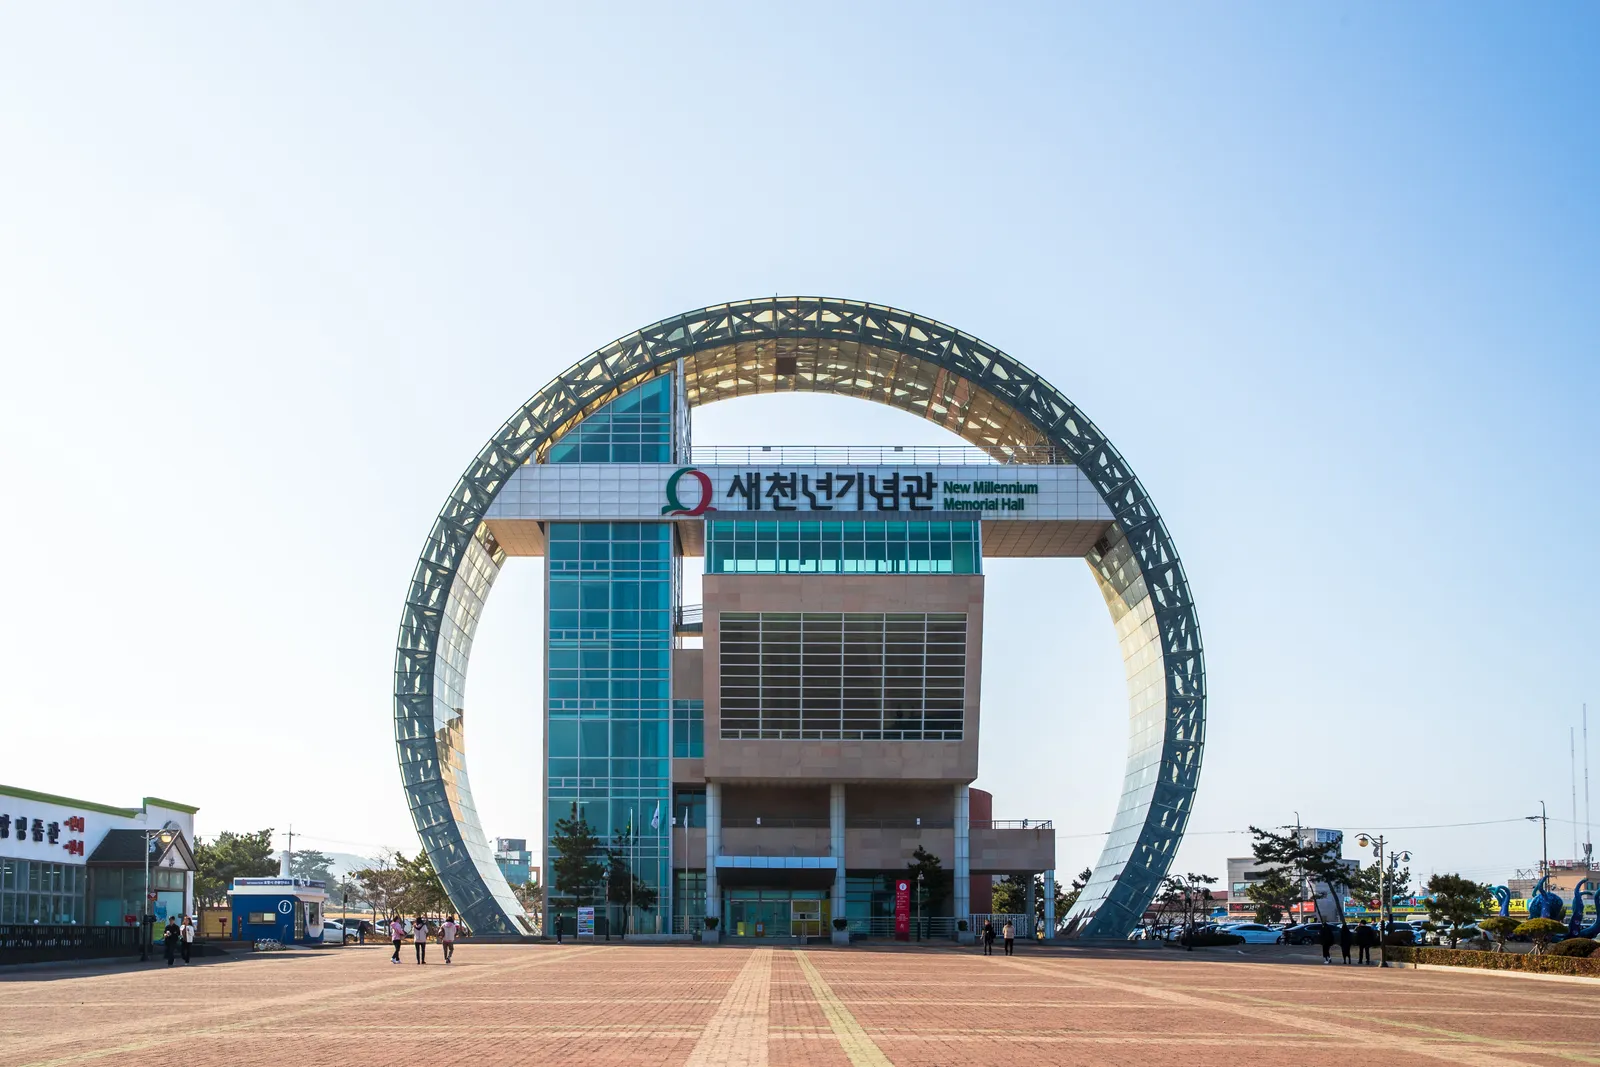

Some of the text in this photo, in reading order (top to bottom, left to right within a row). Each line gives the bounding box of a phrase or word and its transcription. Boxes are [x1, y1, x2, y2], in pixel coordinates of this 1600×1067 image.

[726, 471, 938, 511] 새천년기념관
[943, 481, 1038, 494] New Millennium
[943, 498, 1024, 511] Memorial Hall
